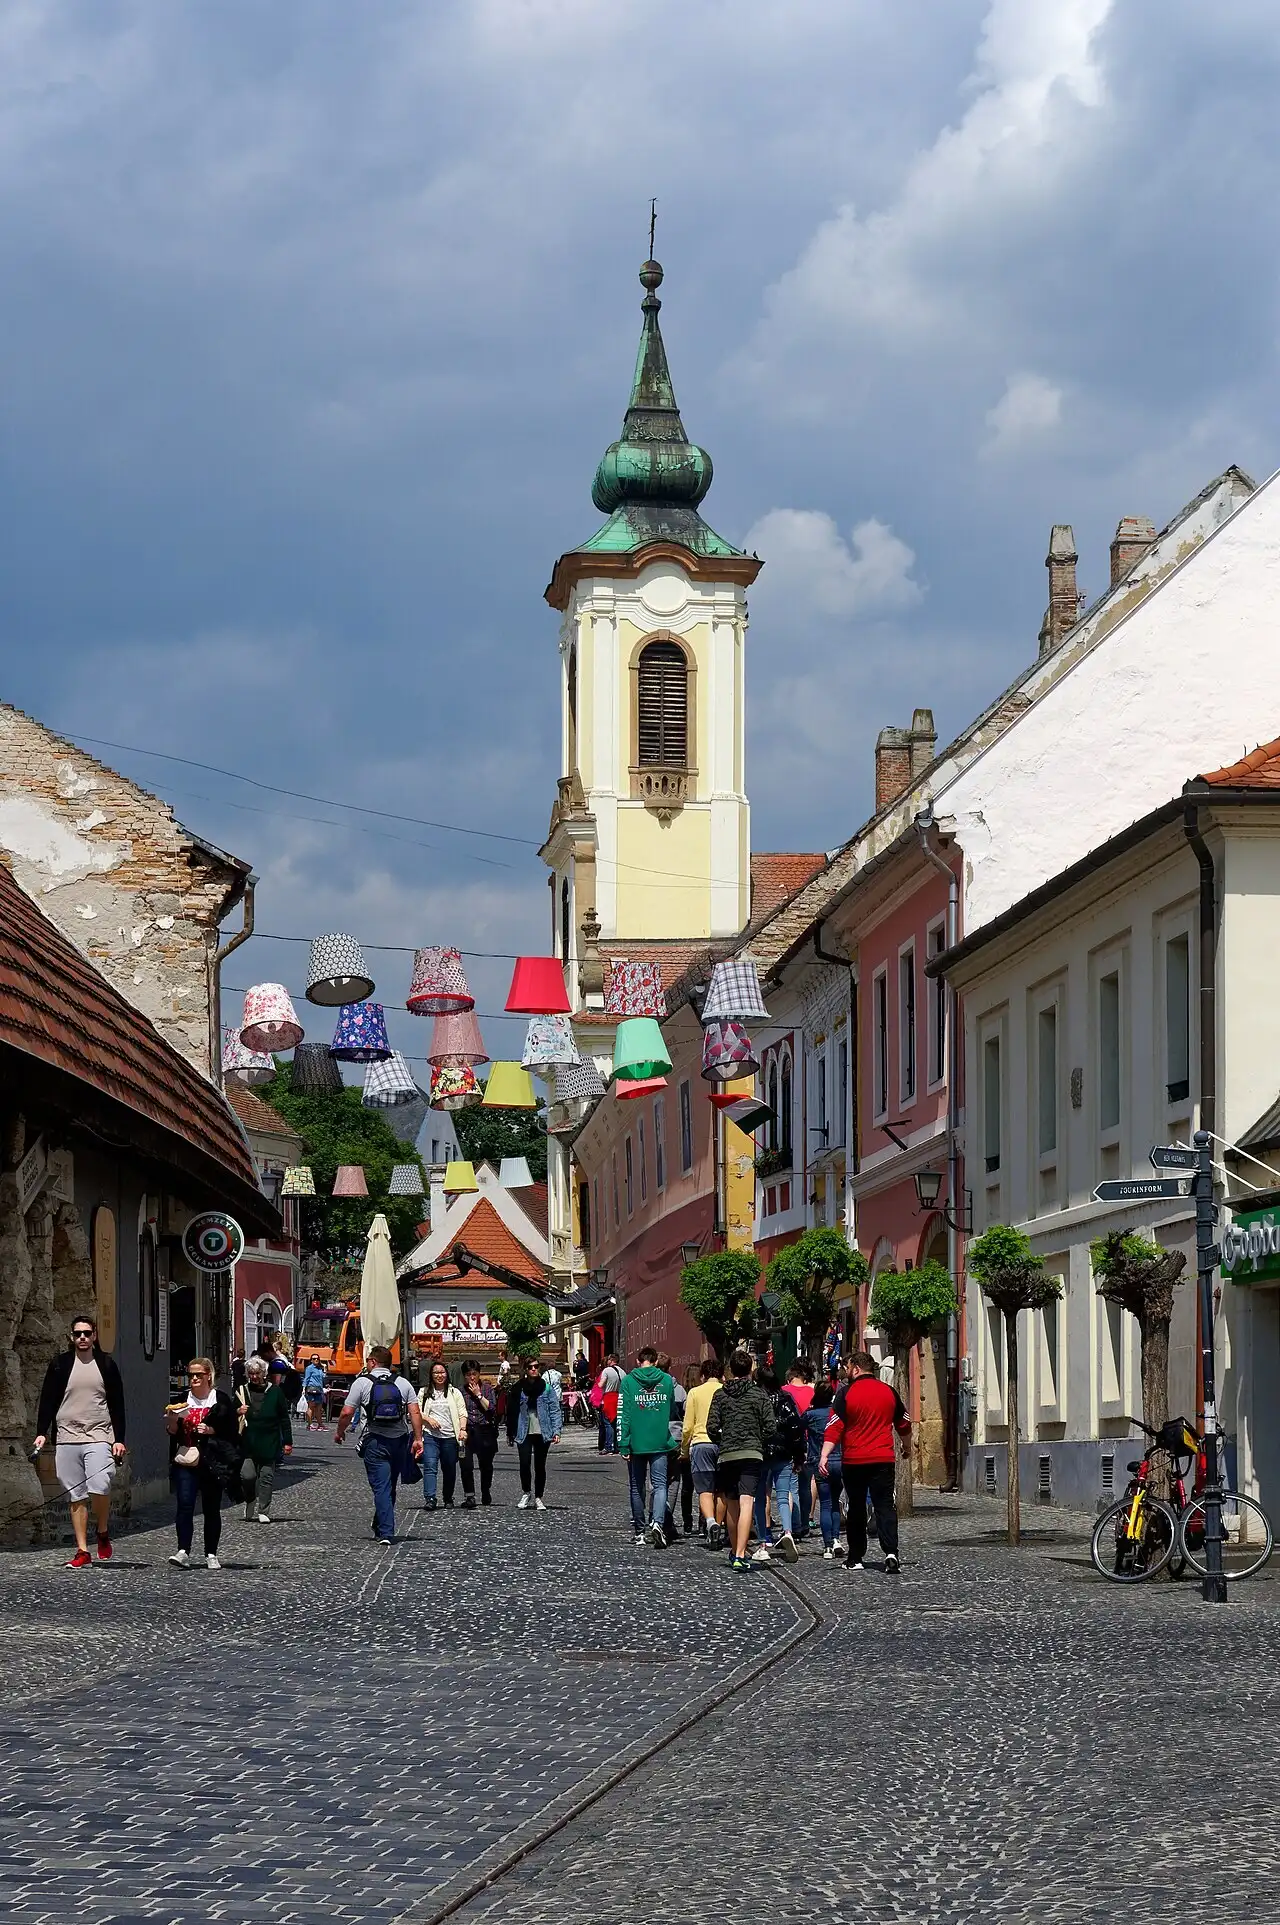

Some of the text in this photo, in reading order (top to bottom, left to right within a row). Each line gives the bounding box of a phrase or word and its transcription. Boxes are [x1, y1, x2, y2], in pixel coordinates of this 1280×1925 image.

[1120, 1185, 1163, 1195] TOURINFORM
[196, 1217, 234, 1231] NEMZETI
[208, 1237, 219, 1248] T
[634, 1393, 667, 1402] HOLLISTER
